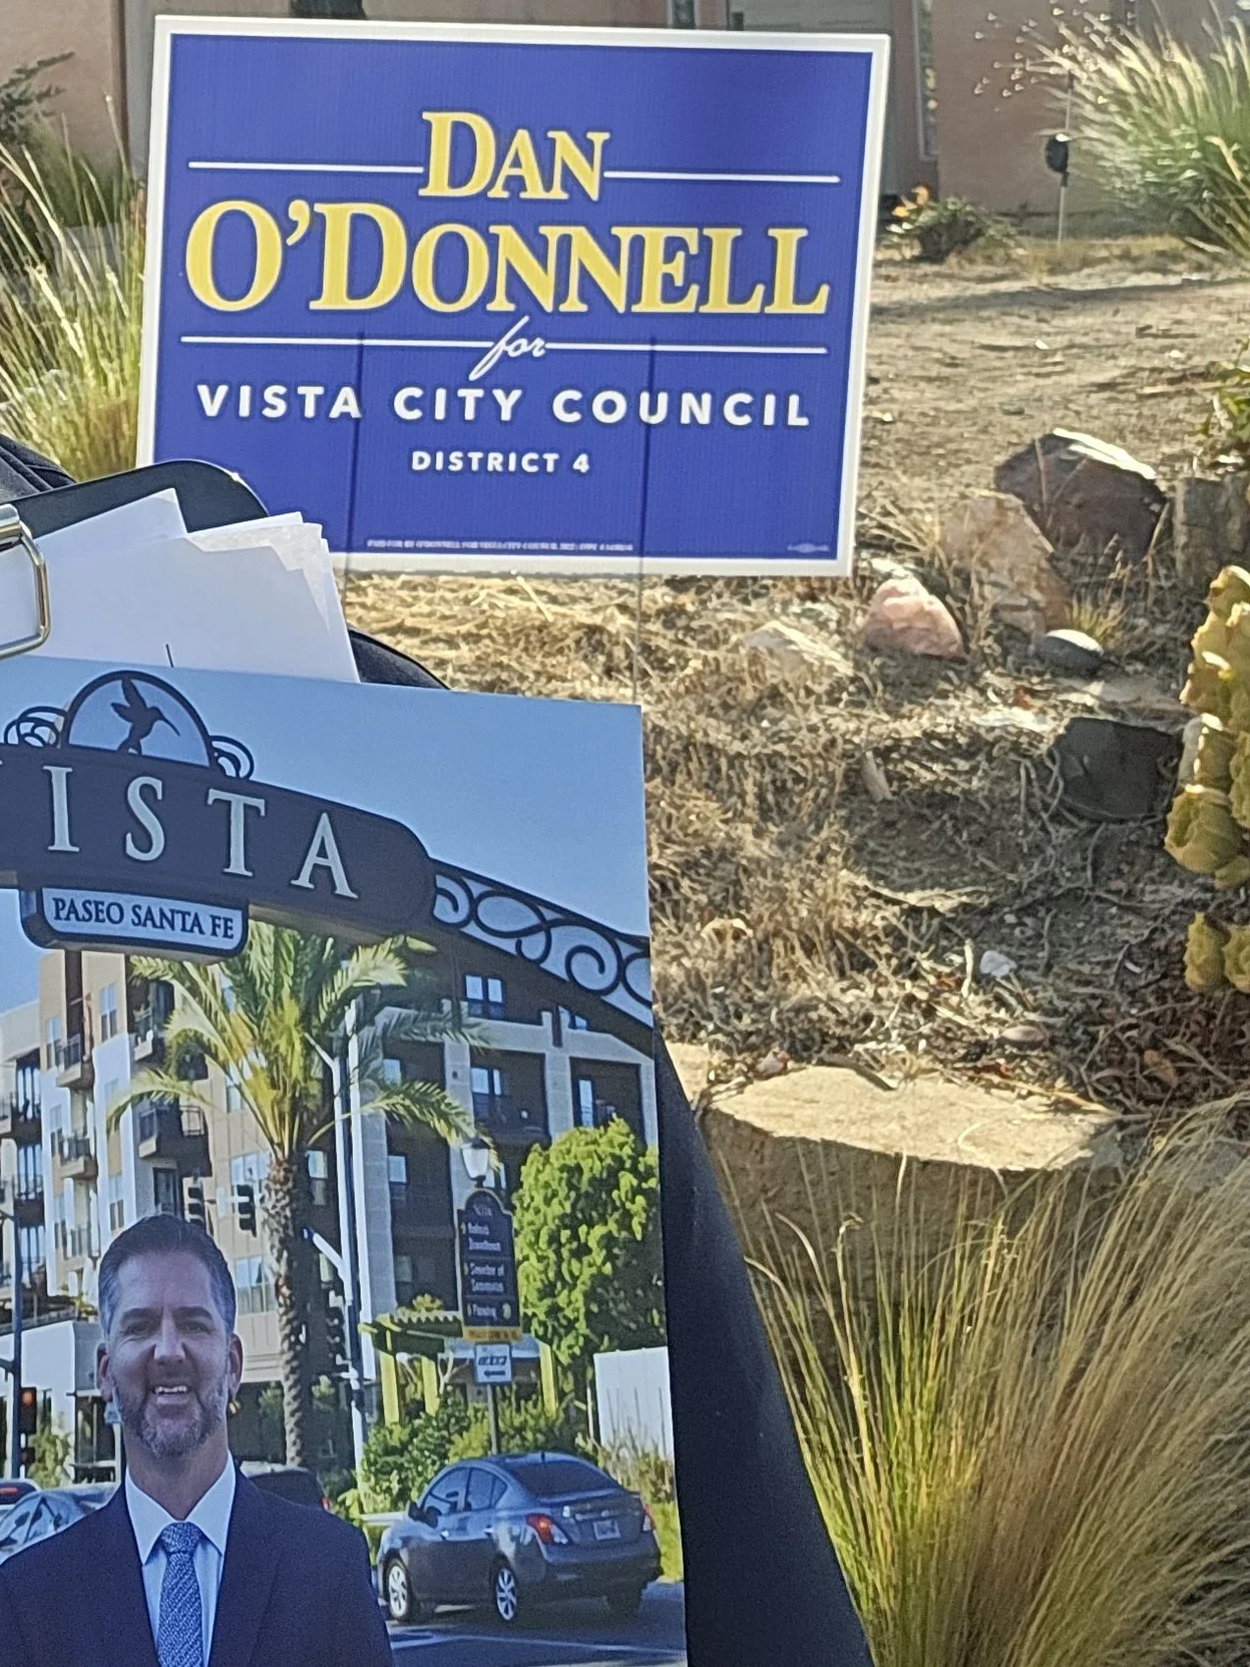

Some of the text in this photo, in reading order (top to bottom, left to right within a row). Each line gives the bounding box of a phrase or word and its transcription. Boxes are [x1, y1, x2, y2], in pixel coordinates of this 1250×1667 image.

[418, 111, 611, 201] DAN
[185, 200, 831, 315] O'DONNELL
[469, 316, 548, 381] for
[197, 383, 812, 428] VISTA CITY COUNCIL
[411, 451, 591, 474] DISTRICT 4
[52, 897, 235, 940] PASEO SANTA FE
